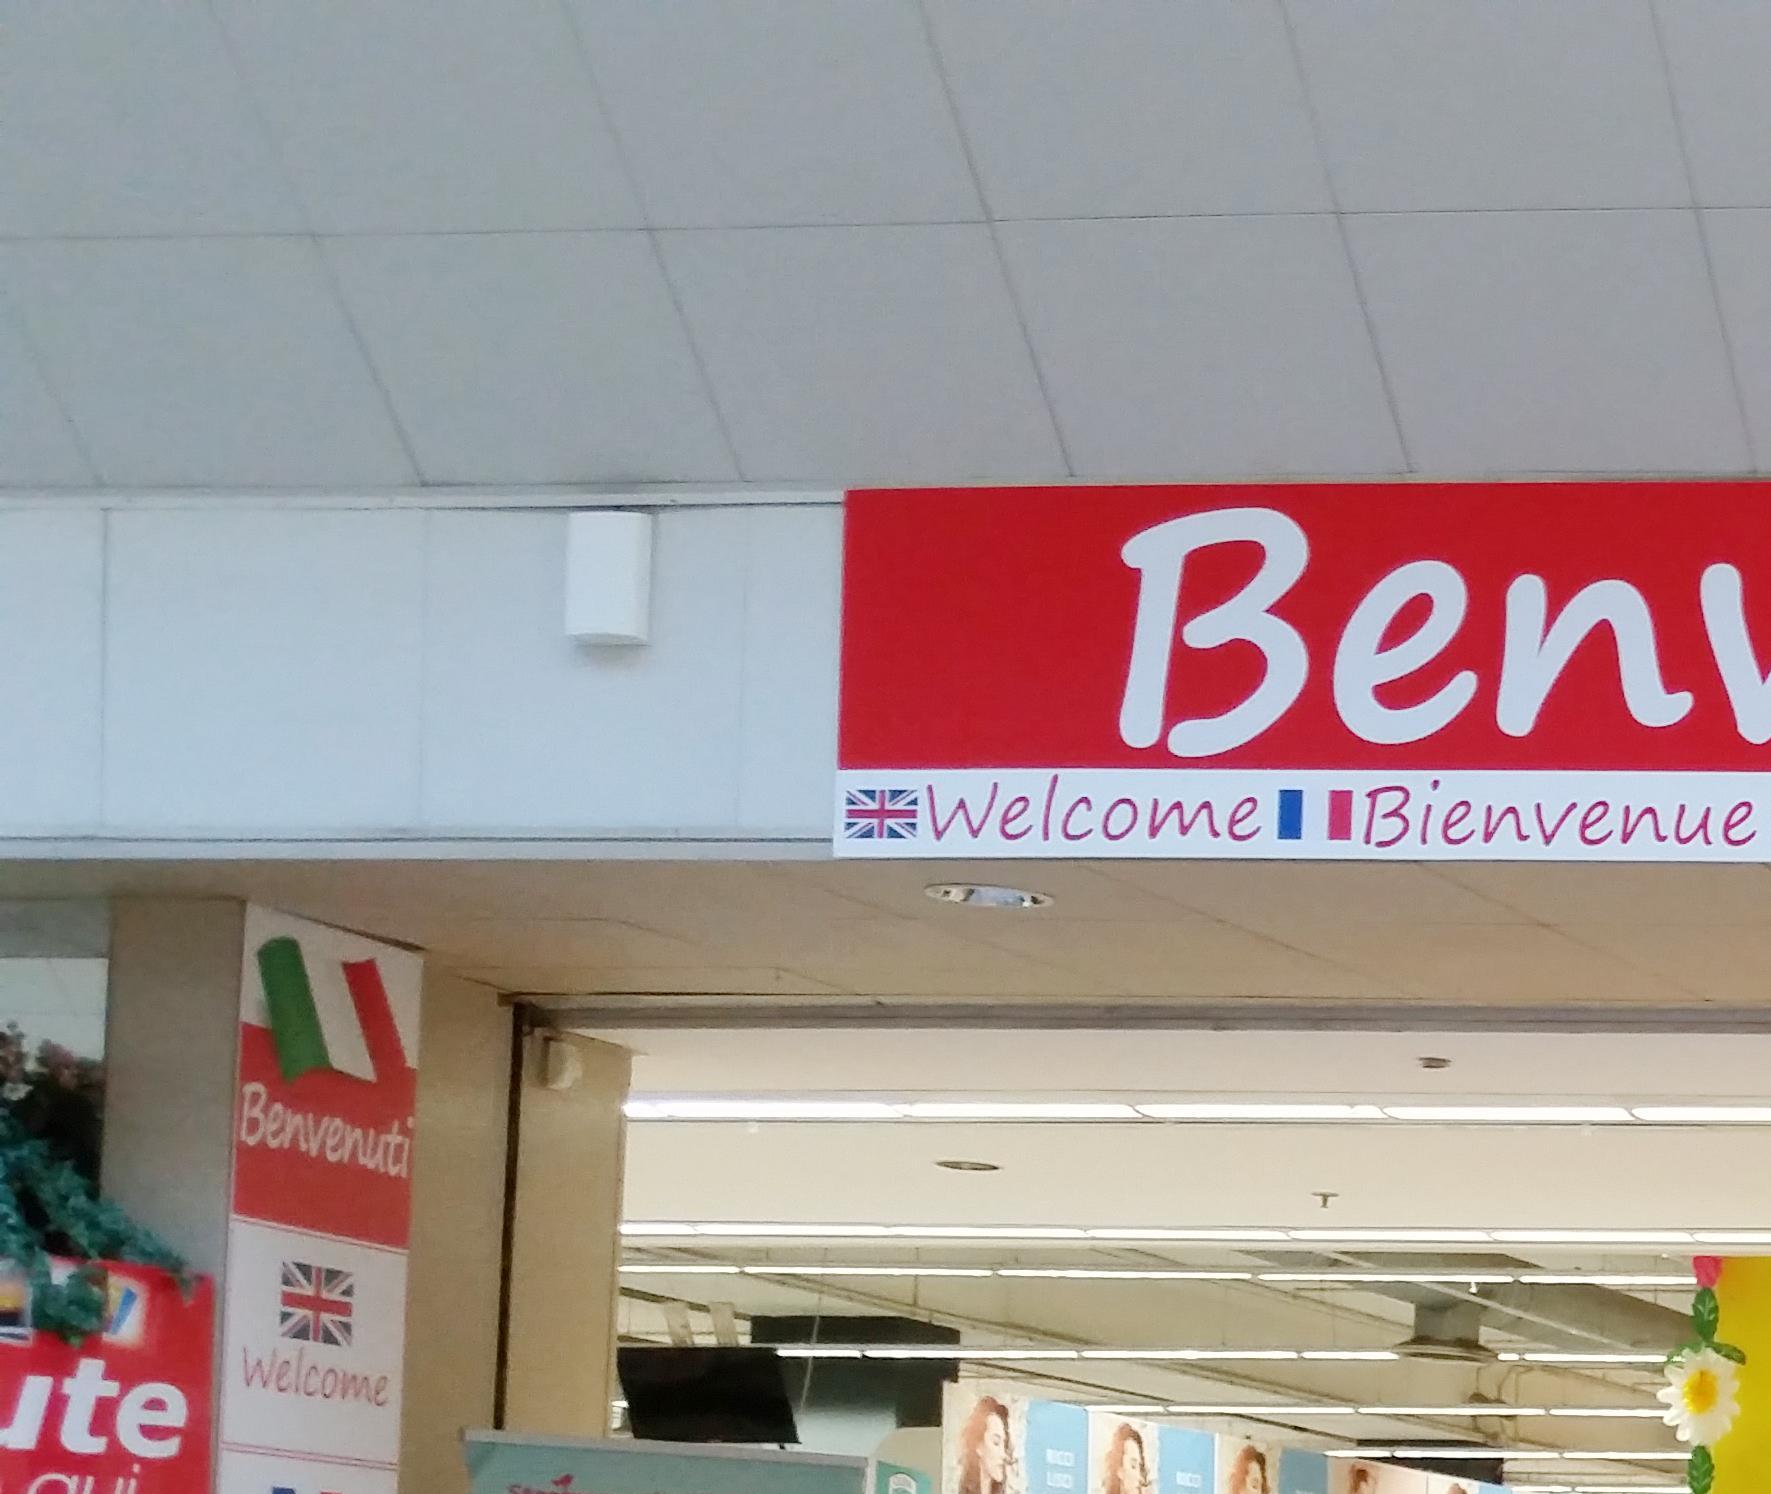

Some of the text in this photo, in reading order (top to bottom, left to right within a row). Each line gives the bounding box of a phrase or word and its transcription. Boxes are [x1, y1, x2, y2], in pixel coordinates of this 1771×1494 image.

[923, 774, 1262, 848] Welcome
[1363, 782, 1757, 850] Bienvenue
[239, 1082, 414, 1180] Benvenuti
[242, 1347, 391, 1407] Welcome
